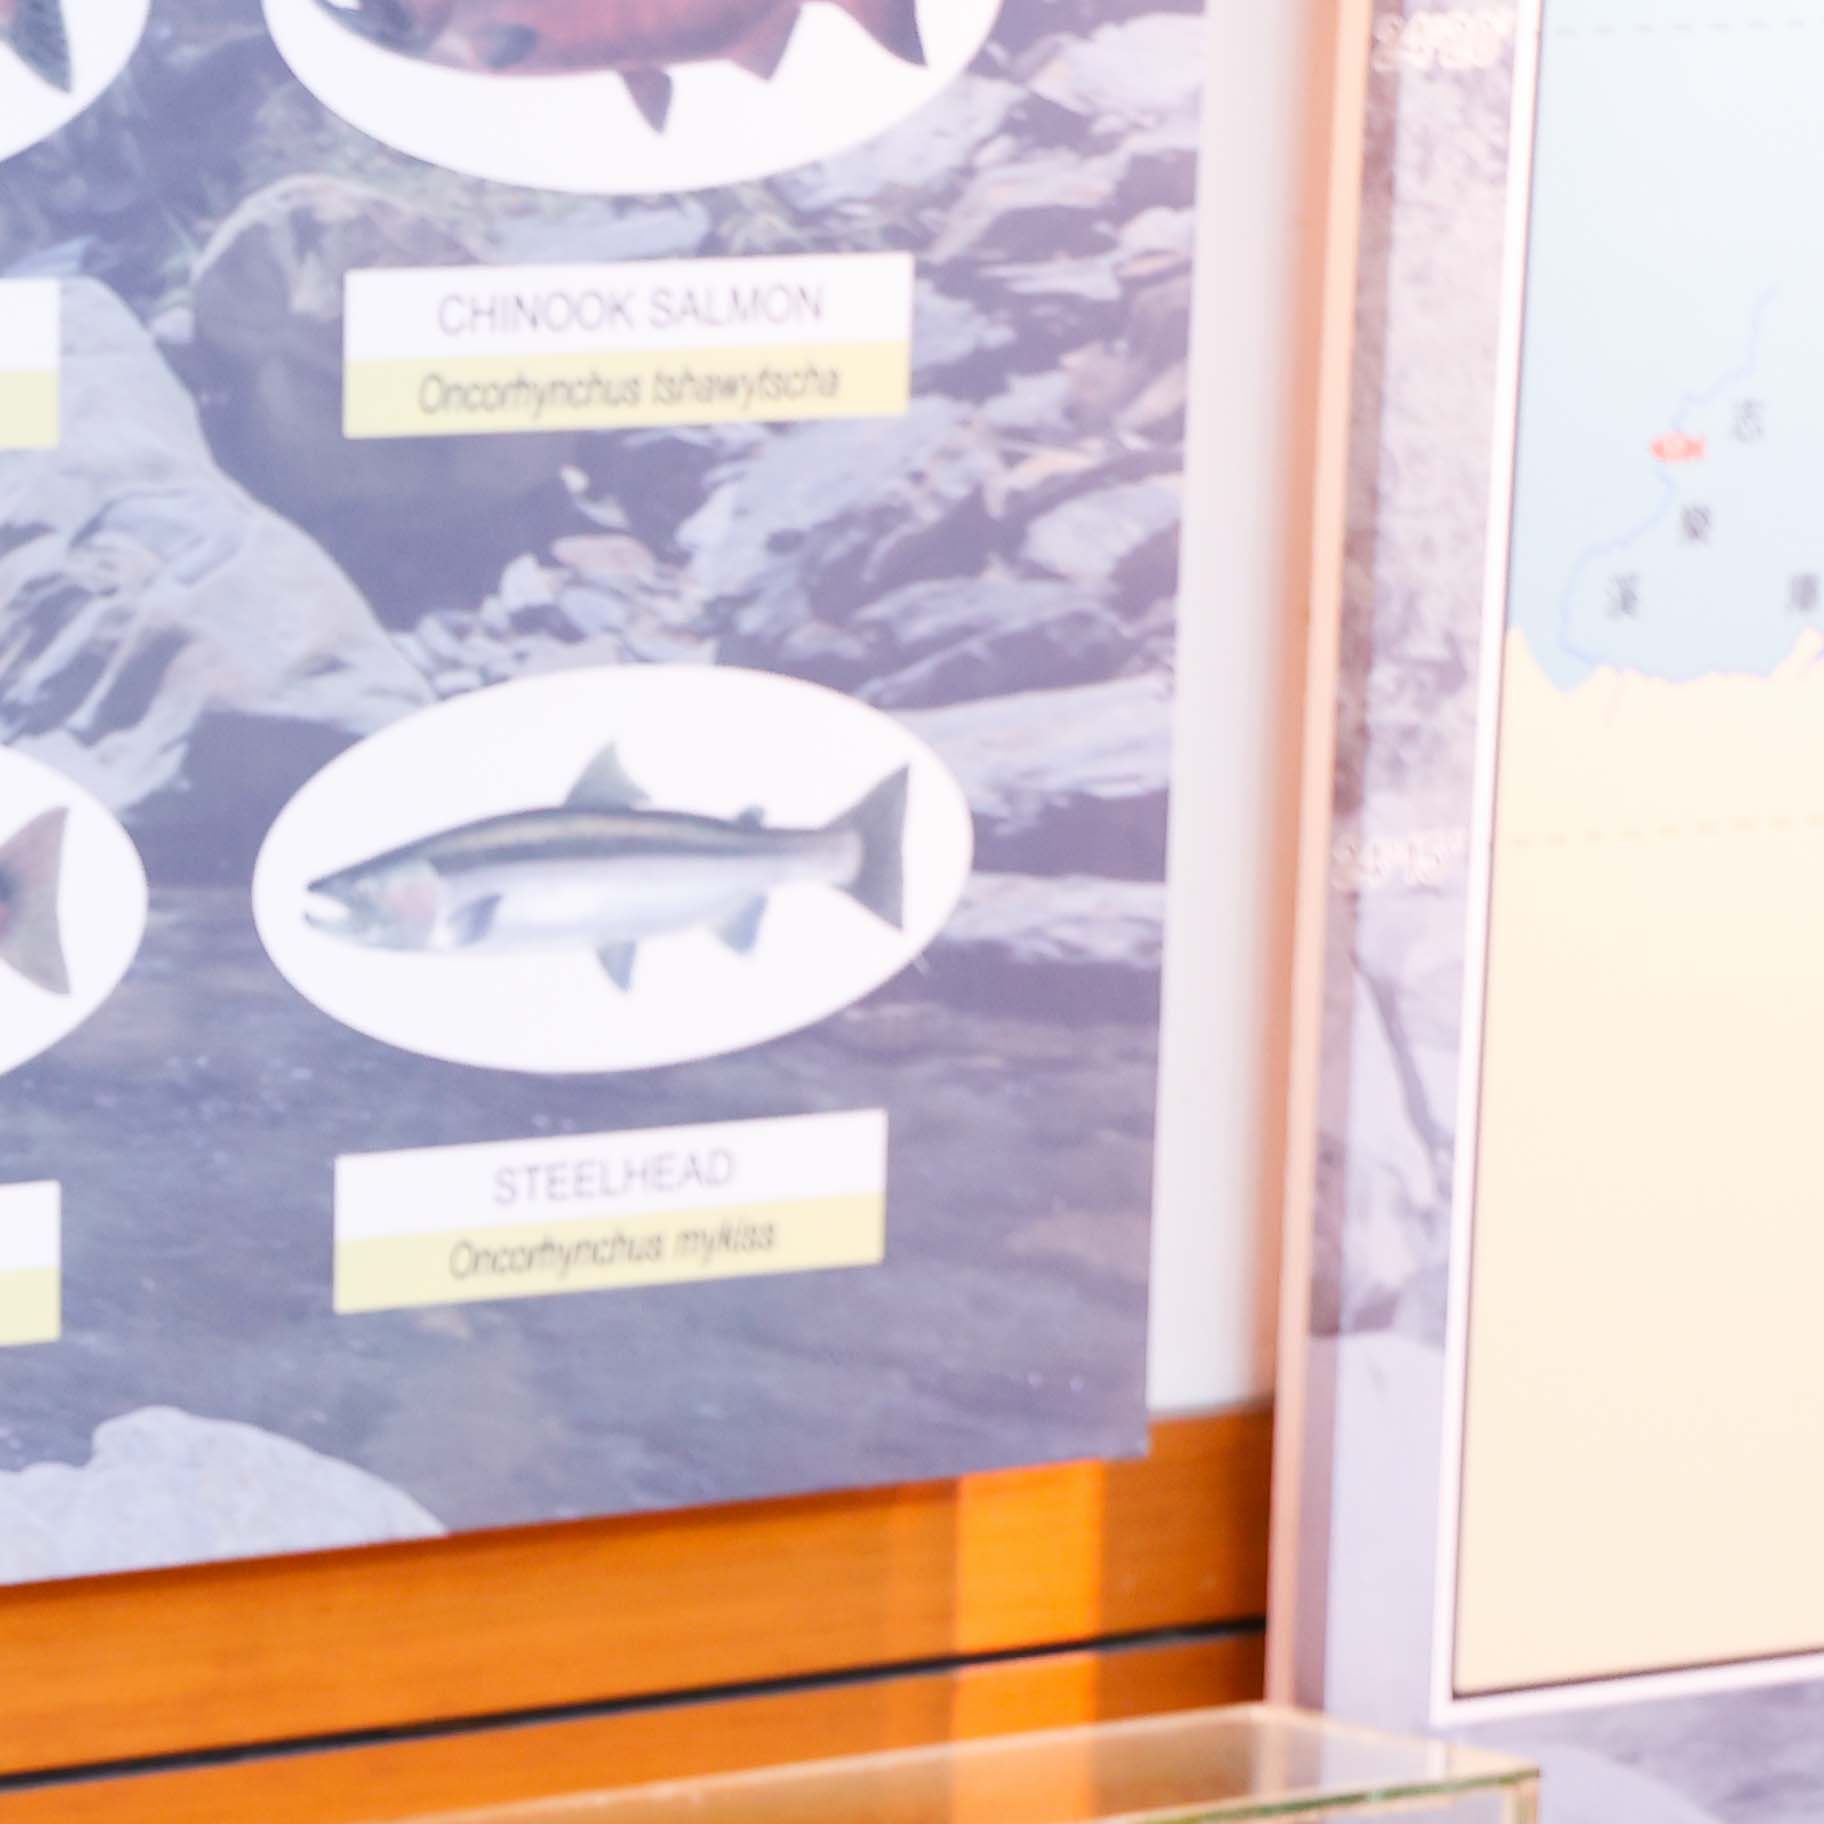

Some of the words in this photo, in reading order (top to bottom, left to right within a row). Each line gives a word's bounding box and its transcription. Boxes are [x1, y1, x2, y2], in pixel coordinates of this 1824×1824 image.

[437, 288, 636, 337] CHINOOK
[649, 283, 824, 328] SALMON
[418, 369, 642, 419] Oncorhynchus
[653, 362, 840, 410] tshawytscha
[493, 1147, 734, 1205] STEELHEAD
[449, 1230, 663, 1280] Oncorhynchus
[675, 1218, 777, 1263] mykiss
